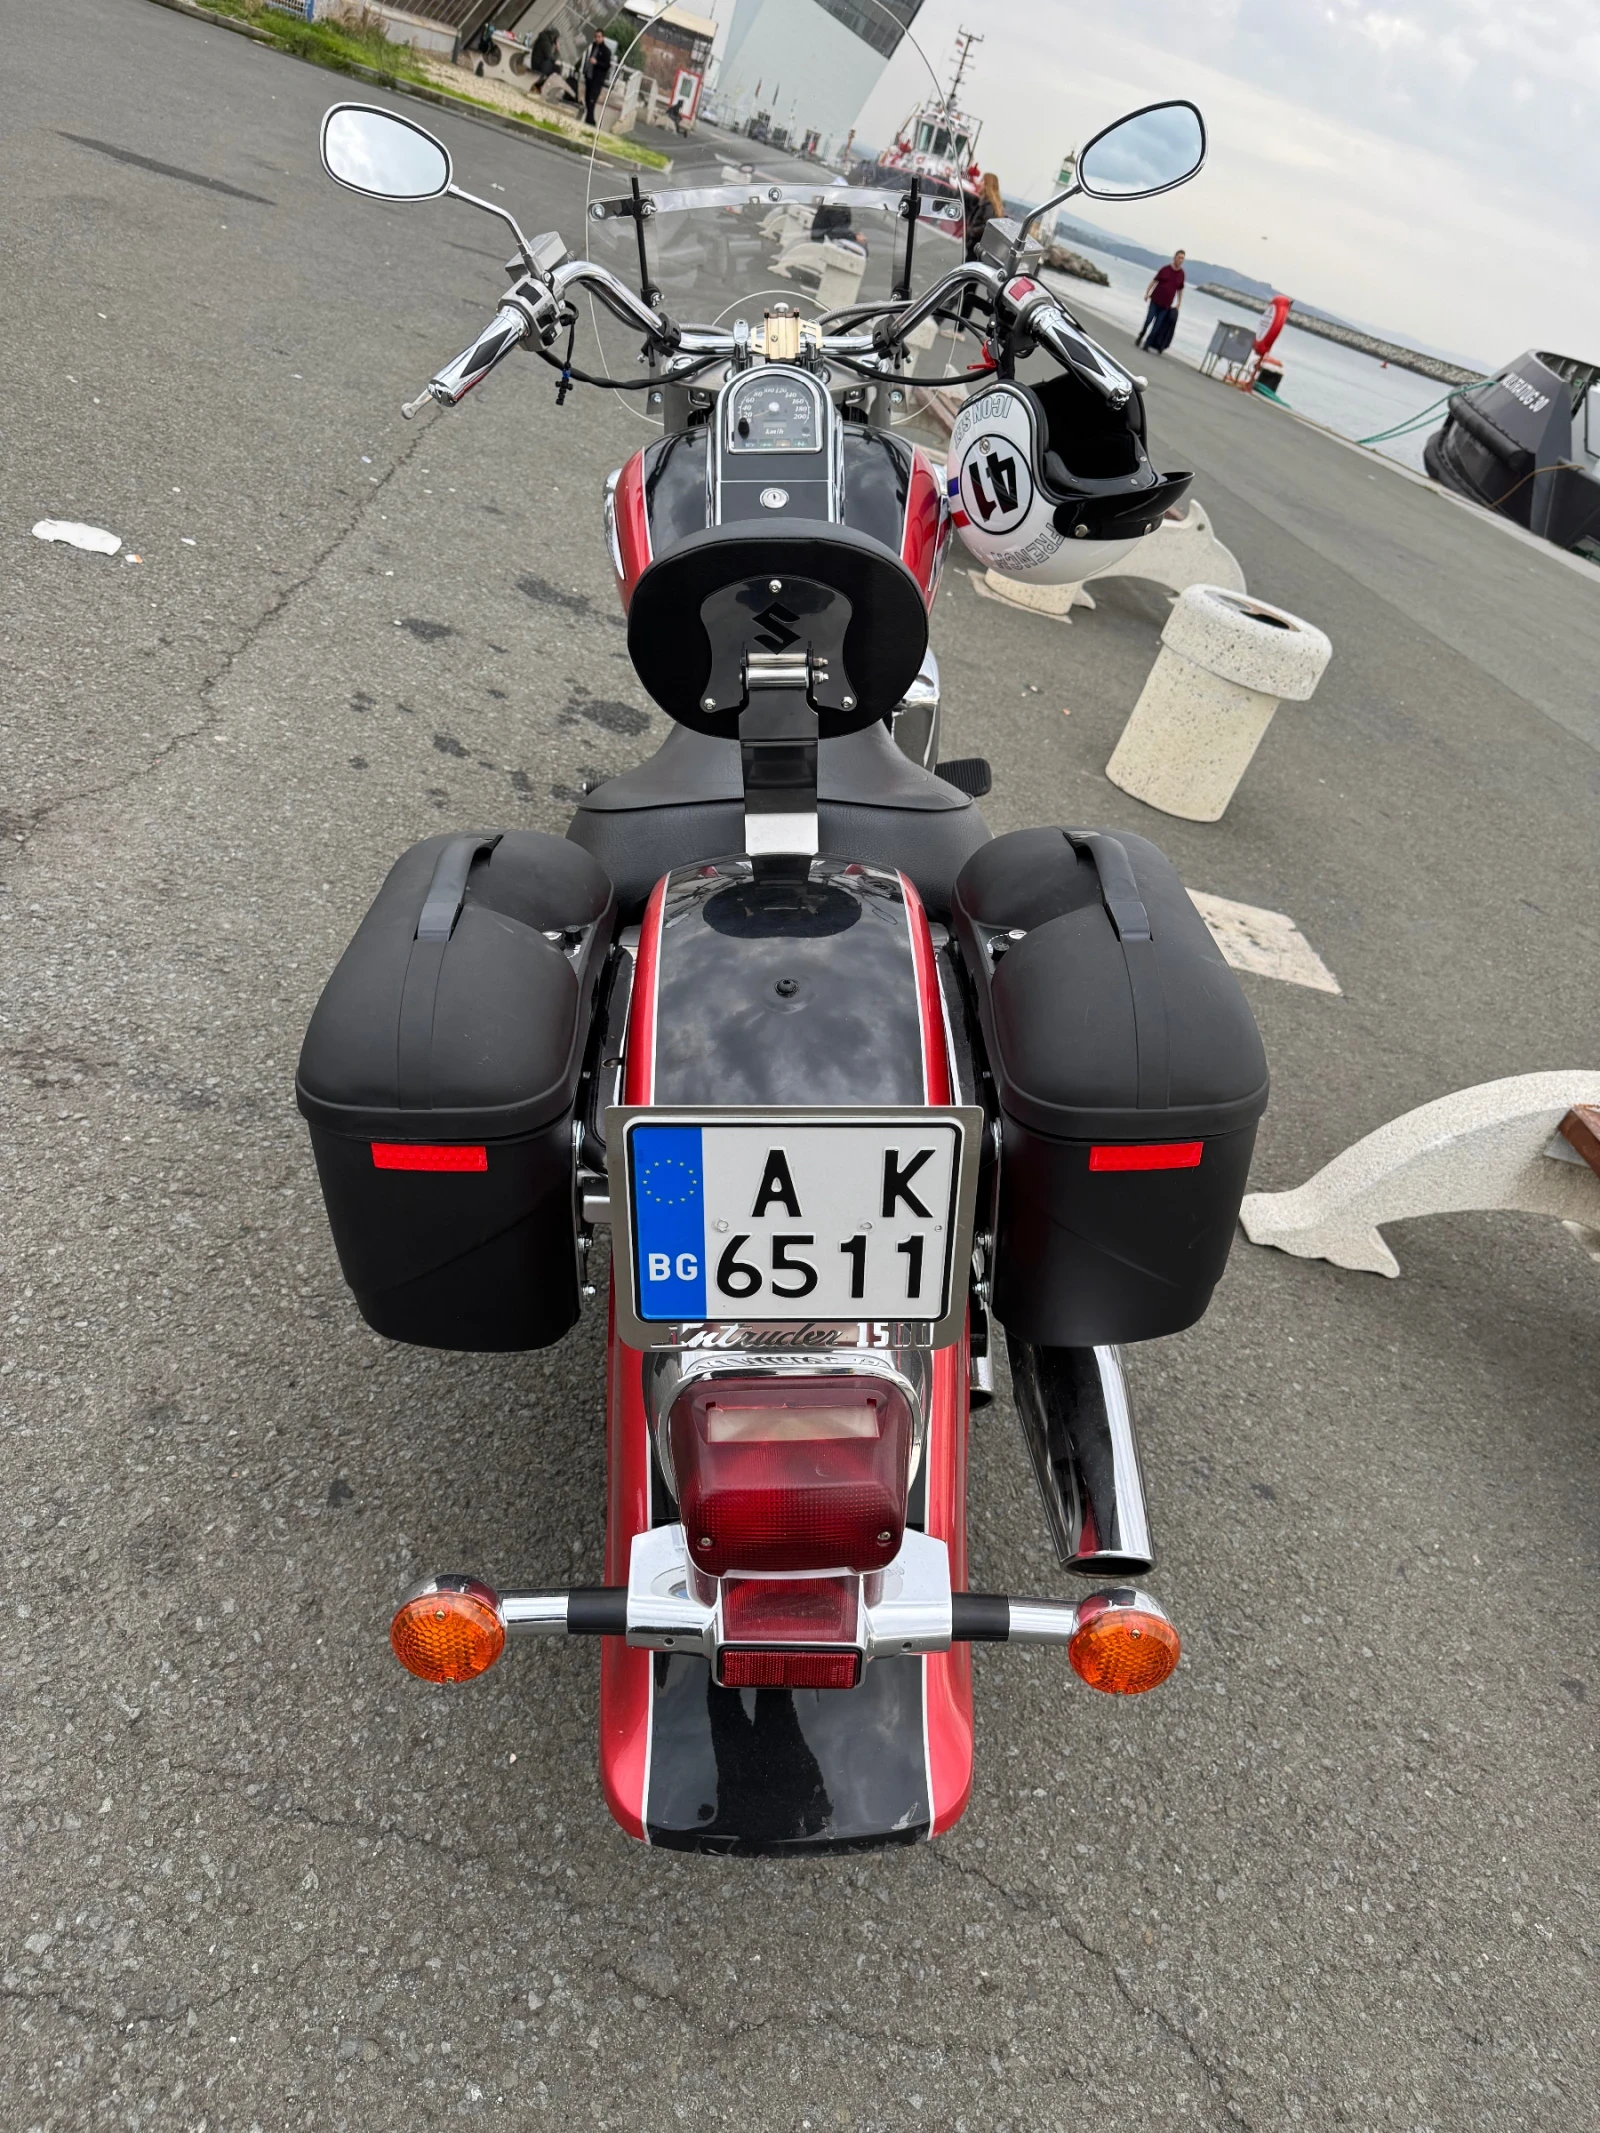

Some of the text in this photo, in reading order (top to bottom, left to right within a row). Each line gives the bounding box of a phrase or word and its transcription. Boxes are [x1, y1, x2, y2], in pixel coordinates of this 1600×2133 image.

[971, 394, 1014, 425] ICON
[968, 451, 1018, 522] 41
[990, 522, 1066, 571] FRENCH
[751, 1149, 937, 1218] A K
[650, 1254, 699, 1281] BG
[716, 1234, 925, 1299] 6511
[651, 1322, 935, 1348] Intruder 1500
